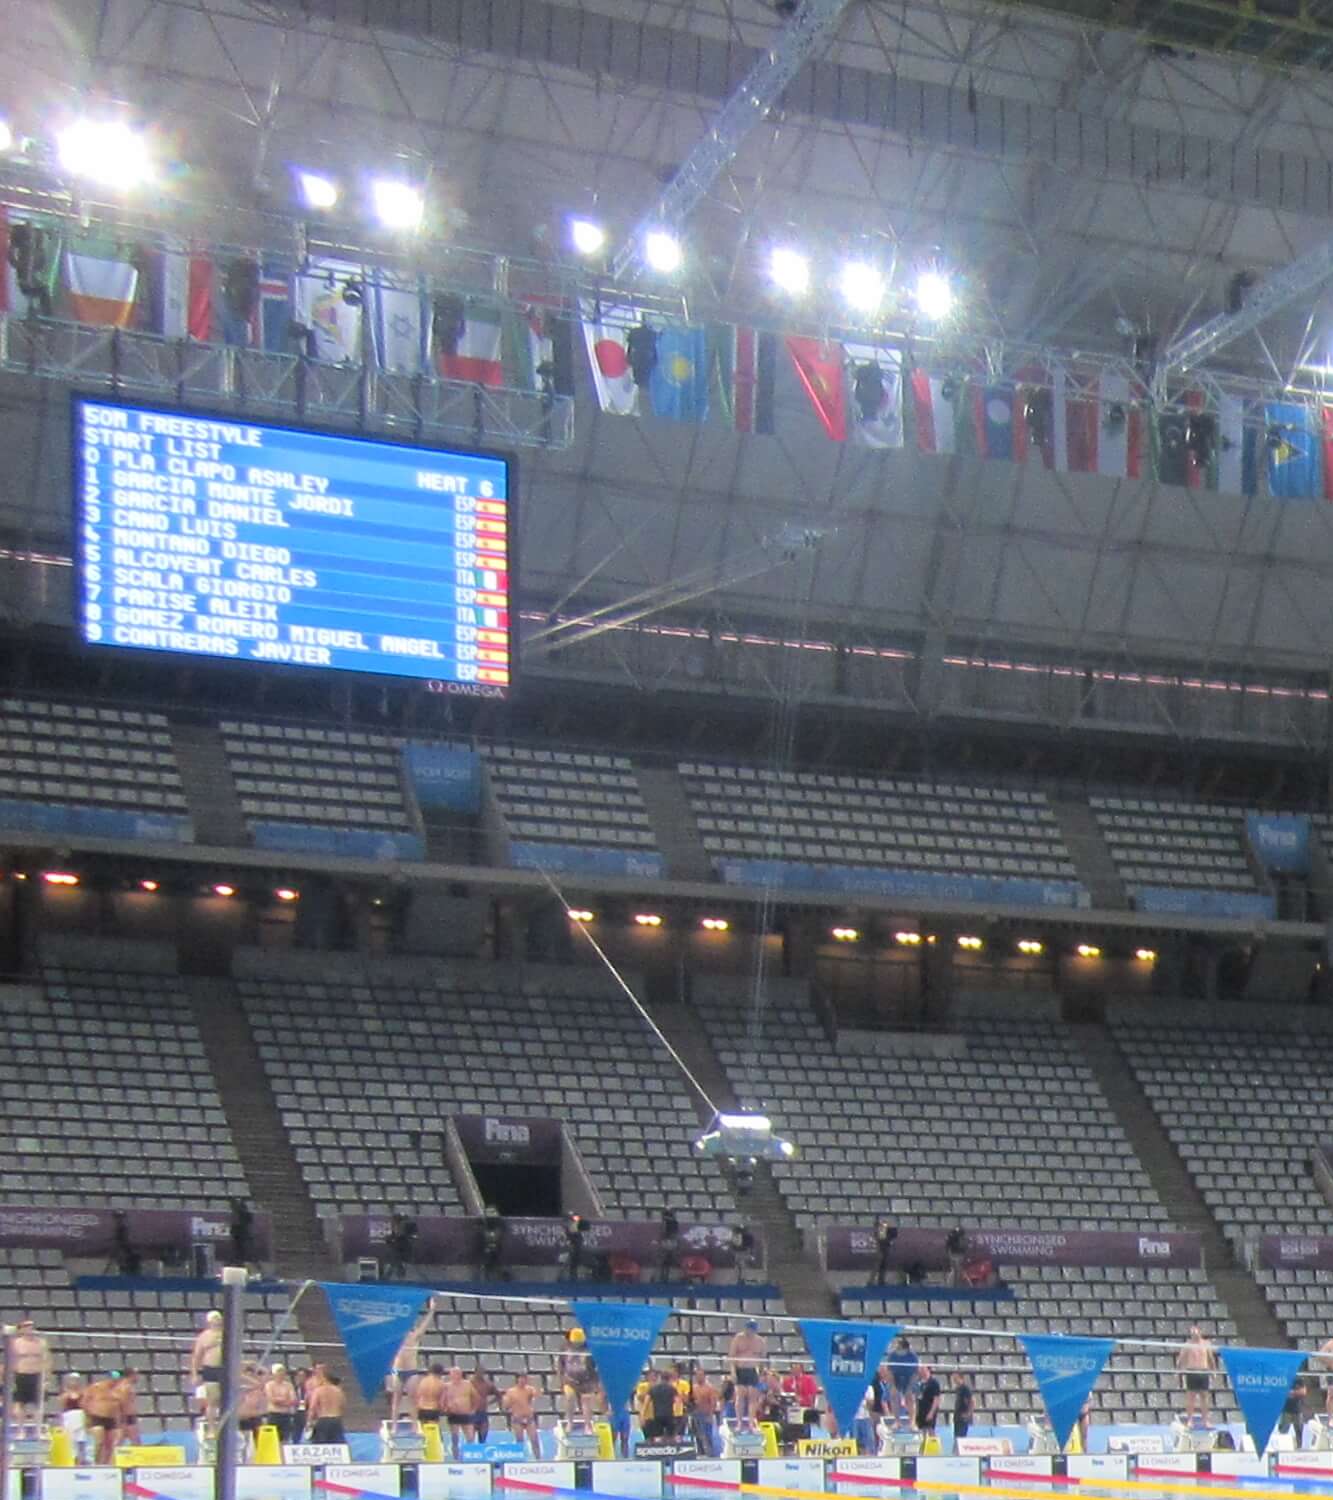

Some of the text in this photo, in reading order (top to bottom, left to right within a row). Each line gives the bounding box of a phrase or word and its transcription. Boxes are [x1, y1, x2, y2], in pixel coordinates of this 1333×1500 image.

[139, 414, 263, 447] FREESTYLE
[84, 427, 494, 497] START LIST HEAT 6
[112, 450, 155, 471] PLA
[167, 457, 236, 481] CLAPO
[248, 467, 329, 494] ASHLEY
[455, 496, 475, 513] ESP
[84, 486, 475, 549] 2 GARCIA DANIEL ESP
[86, 466, 475, 531] 1 GARCIA MONTE JORDI ESP
[84, 524, 475, 586] 4 MONTANO DIEGO ITA
[85, 506, 475, 568] 3 CANO LUIS ESP
[86, 545, 100, 562] 5
[235, 561, 317, 587] CARLES
[455, 587, 475, 605] ESP
[86, 564, 475, 623] 6 SCALA GIORGIO ITA
[86, 603, 475, 661] 8 GOMEZ ROMERO MIGUEL ANGEL ESP
[87, 584, 475, 642] 7 PARISE ALEIX ESP
[86, 623, 475, 681] 9 CONTRERAS JAVIER ESP
[448, 684, 504, 698] OMEGA
[292, 1447, 342, 1457] KAZAN
[636, 1446, 677, 1456] speedo
[805, 1444, 851, 1456] Nikon
